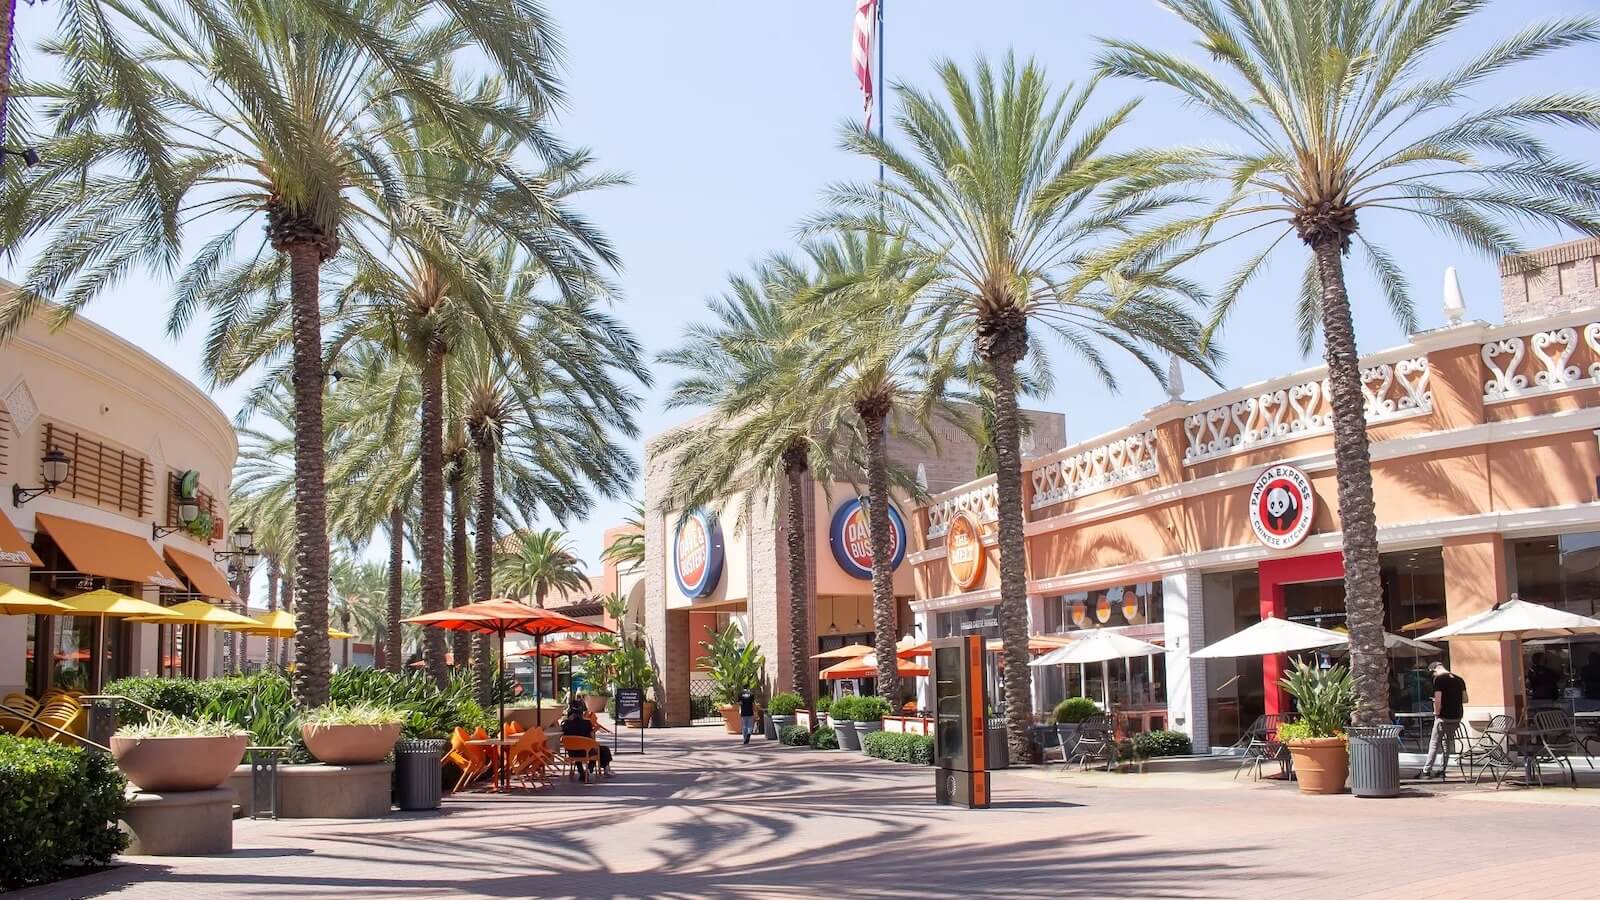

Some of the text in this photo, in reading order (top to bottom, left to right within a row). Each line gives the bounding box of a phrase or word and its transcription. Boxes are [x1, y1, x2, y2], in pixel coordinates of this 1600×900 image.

[1252, 468, 1310, 506] PANDA EXPRESS
[1254, 516, 1309, 546] CHINESE KITCHEN
